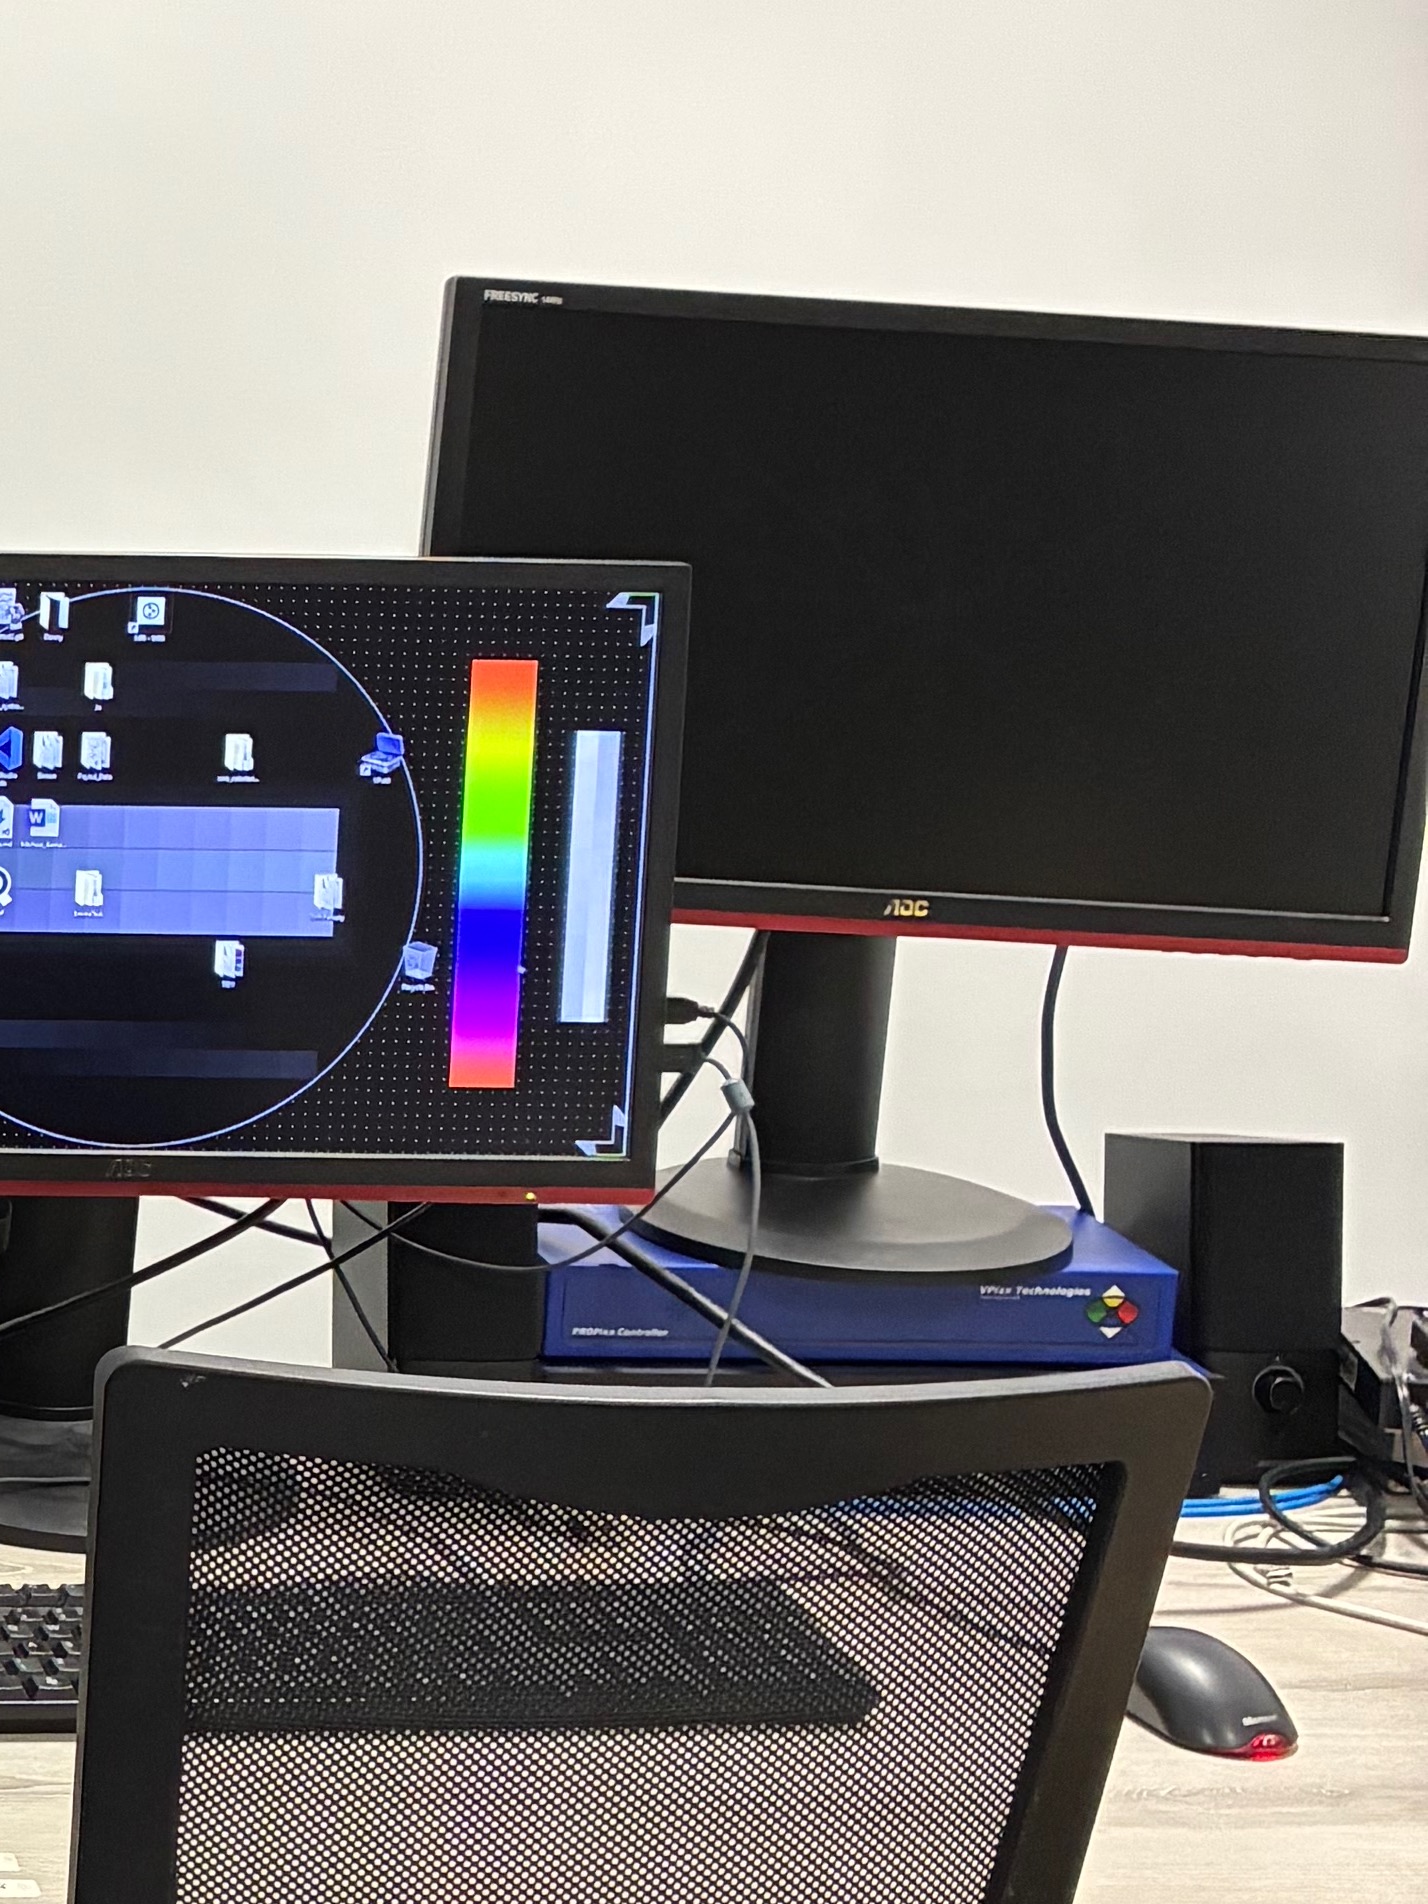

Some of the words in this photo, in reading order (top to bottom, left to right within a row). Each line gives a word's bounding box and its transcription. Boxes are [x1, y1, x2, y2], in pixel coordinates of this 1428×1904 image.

[483, 289, 540, 304] FREESYNC
[883, 898, 930, 918] AOC
[1016, 1286, 1092, 1298] Technologies
[617, 1327, 669, 1337] Controller
